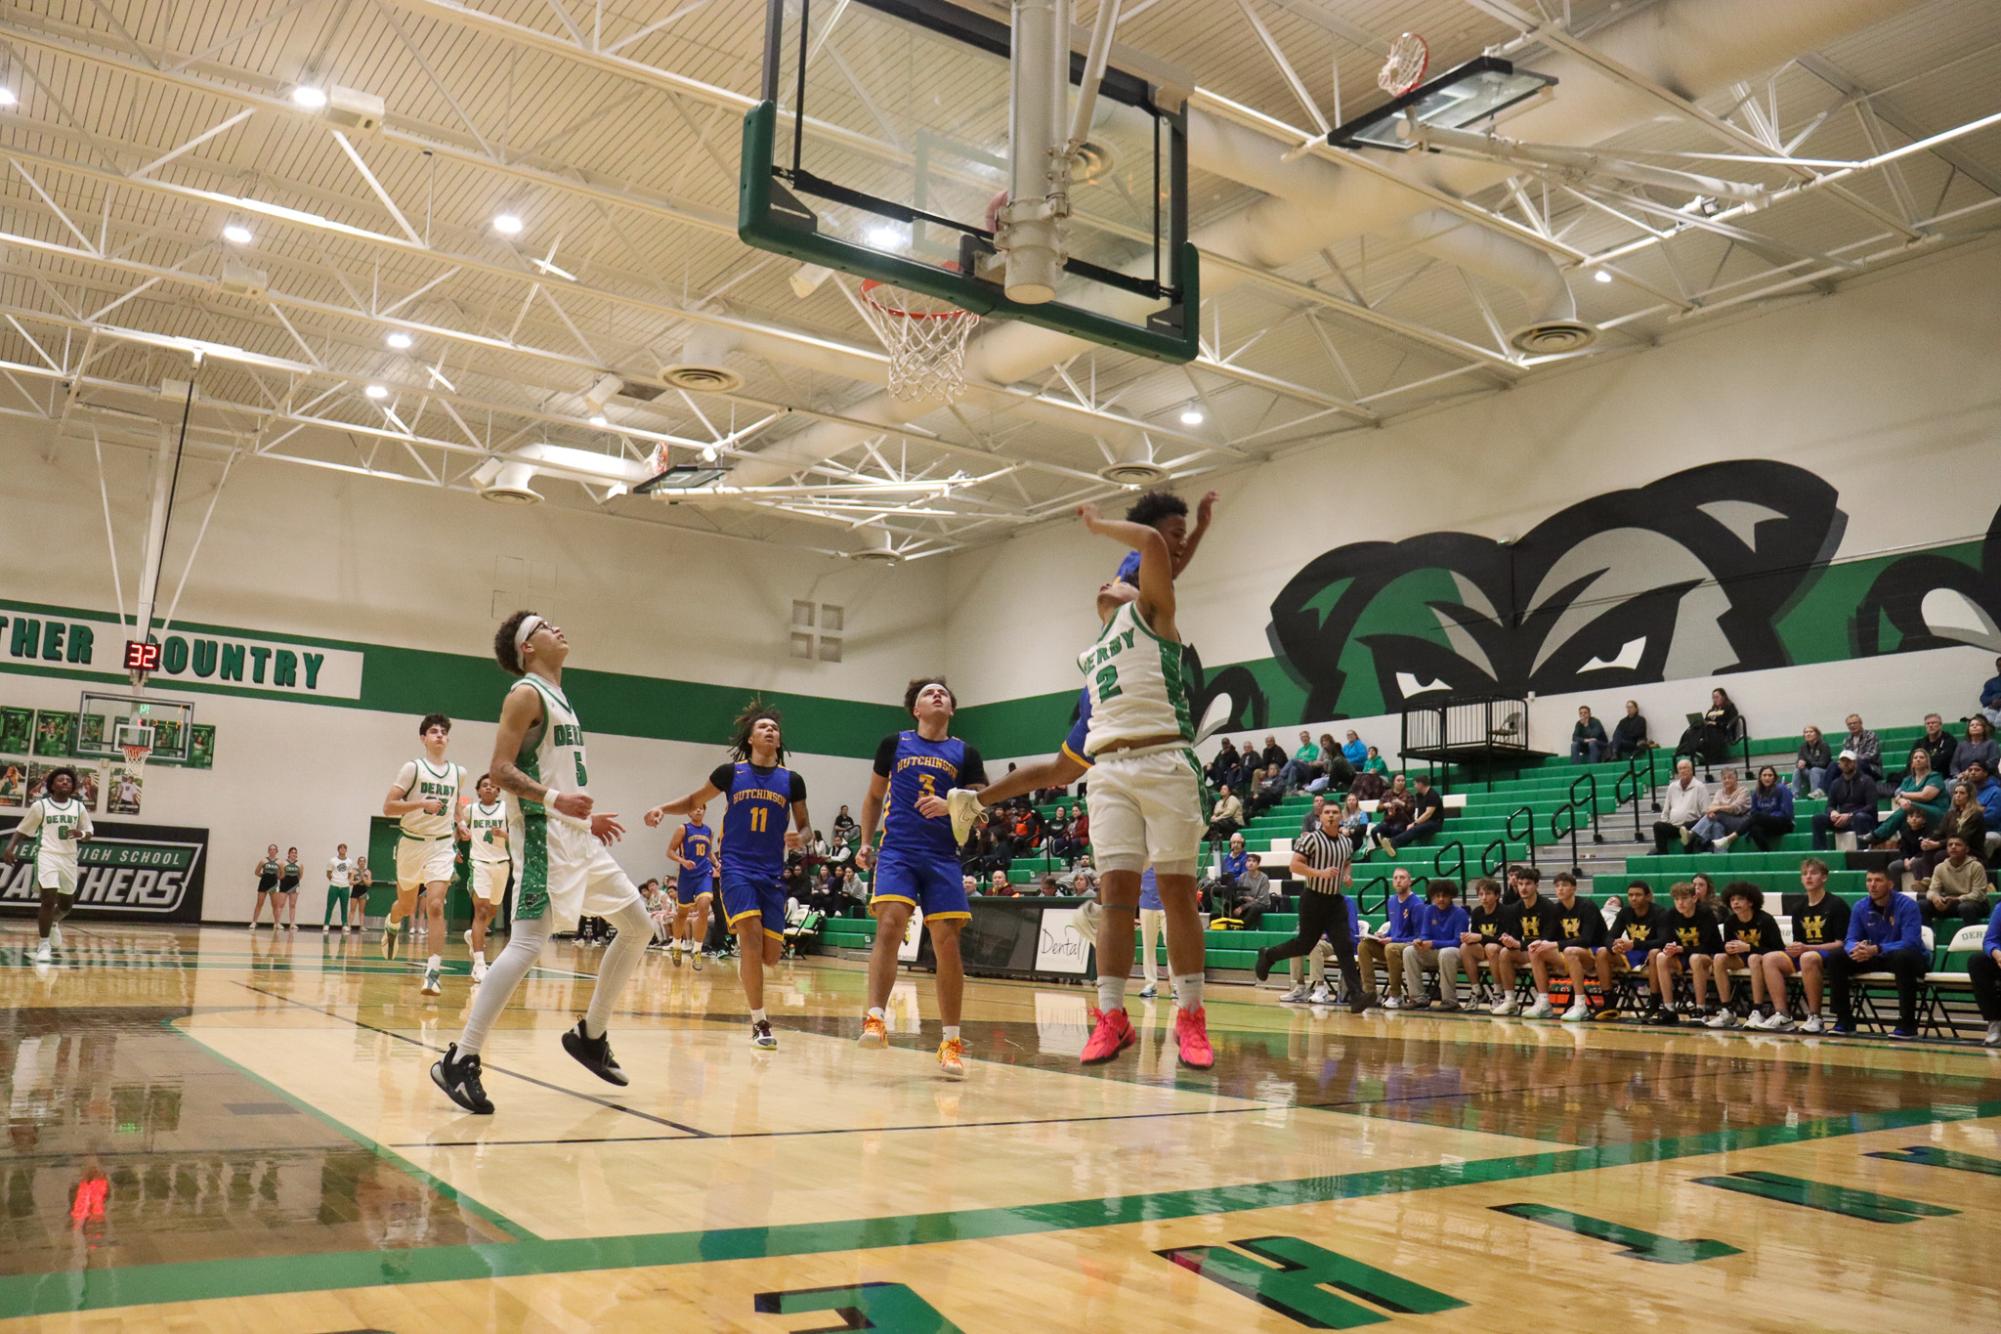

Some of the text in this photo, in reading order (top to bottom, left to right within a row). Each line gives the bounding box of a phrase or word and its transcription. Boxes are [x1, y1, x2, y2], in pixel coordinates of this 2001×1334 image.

[129, 644, 157, 667] 32
[148, 633, 324, 690] OUNTRY
[1078, 627, 1135, 676] ERBY
[1096, 664, 1122, 703] 2
[574, 750, 588, 787] 5
[420, 782, 455, 798] DERBY
[919, 773, 936, 797] 3
[46, 815, 78, 825] DERBY
[750, 806, 769, 833] 11
[119, 850, 180, 865] SCHOOL
